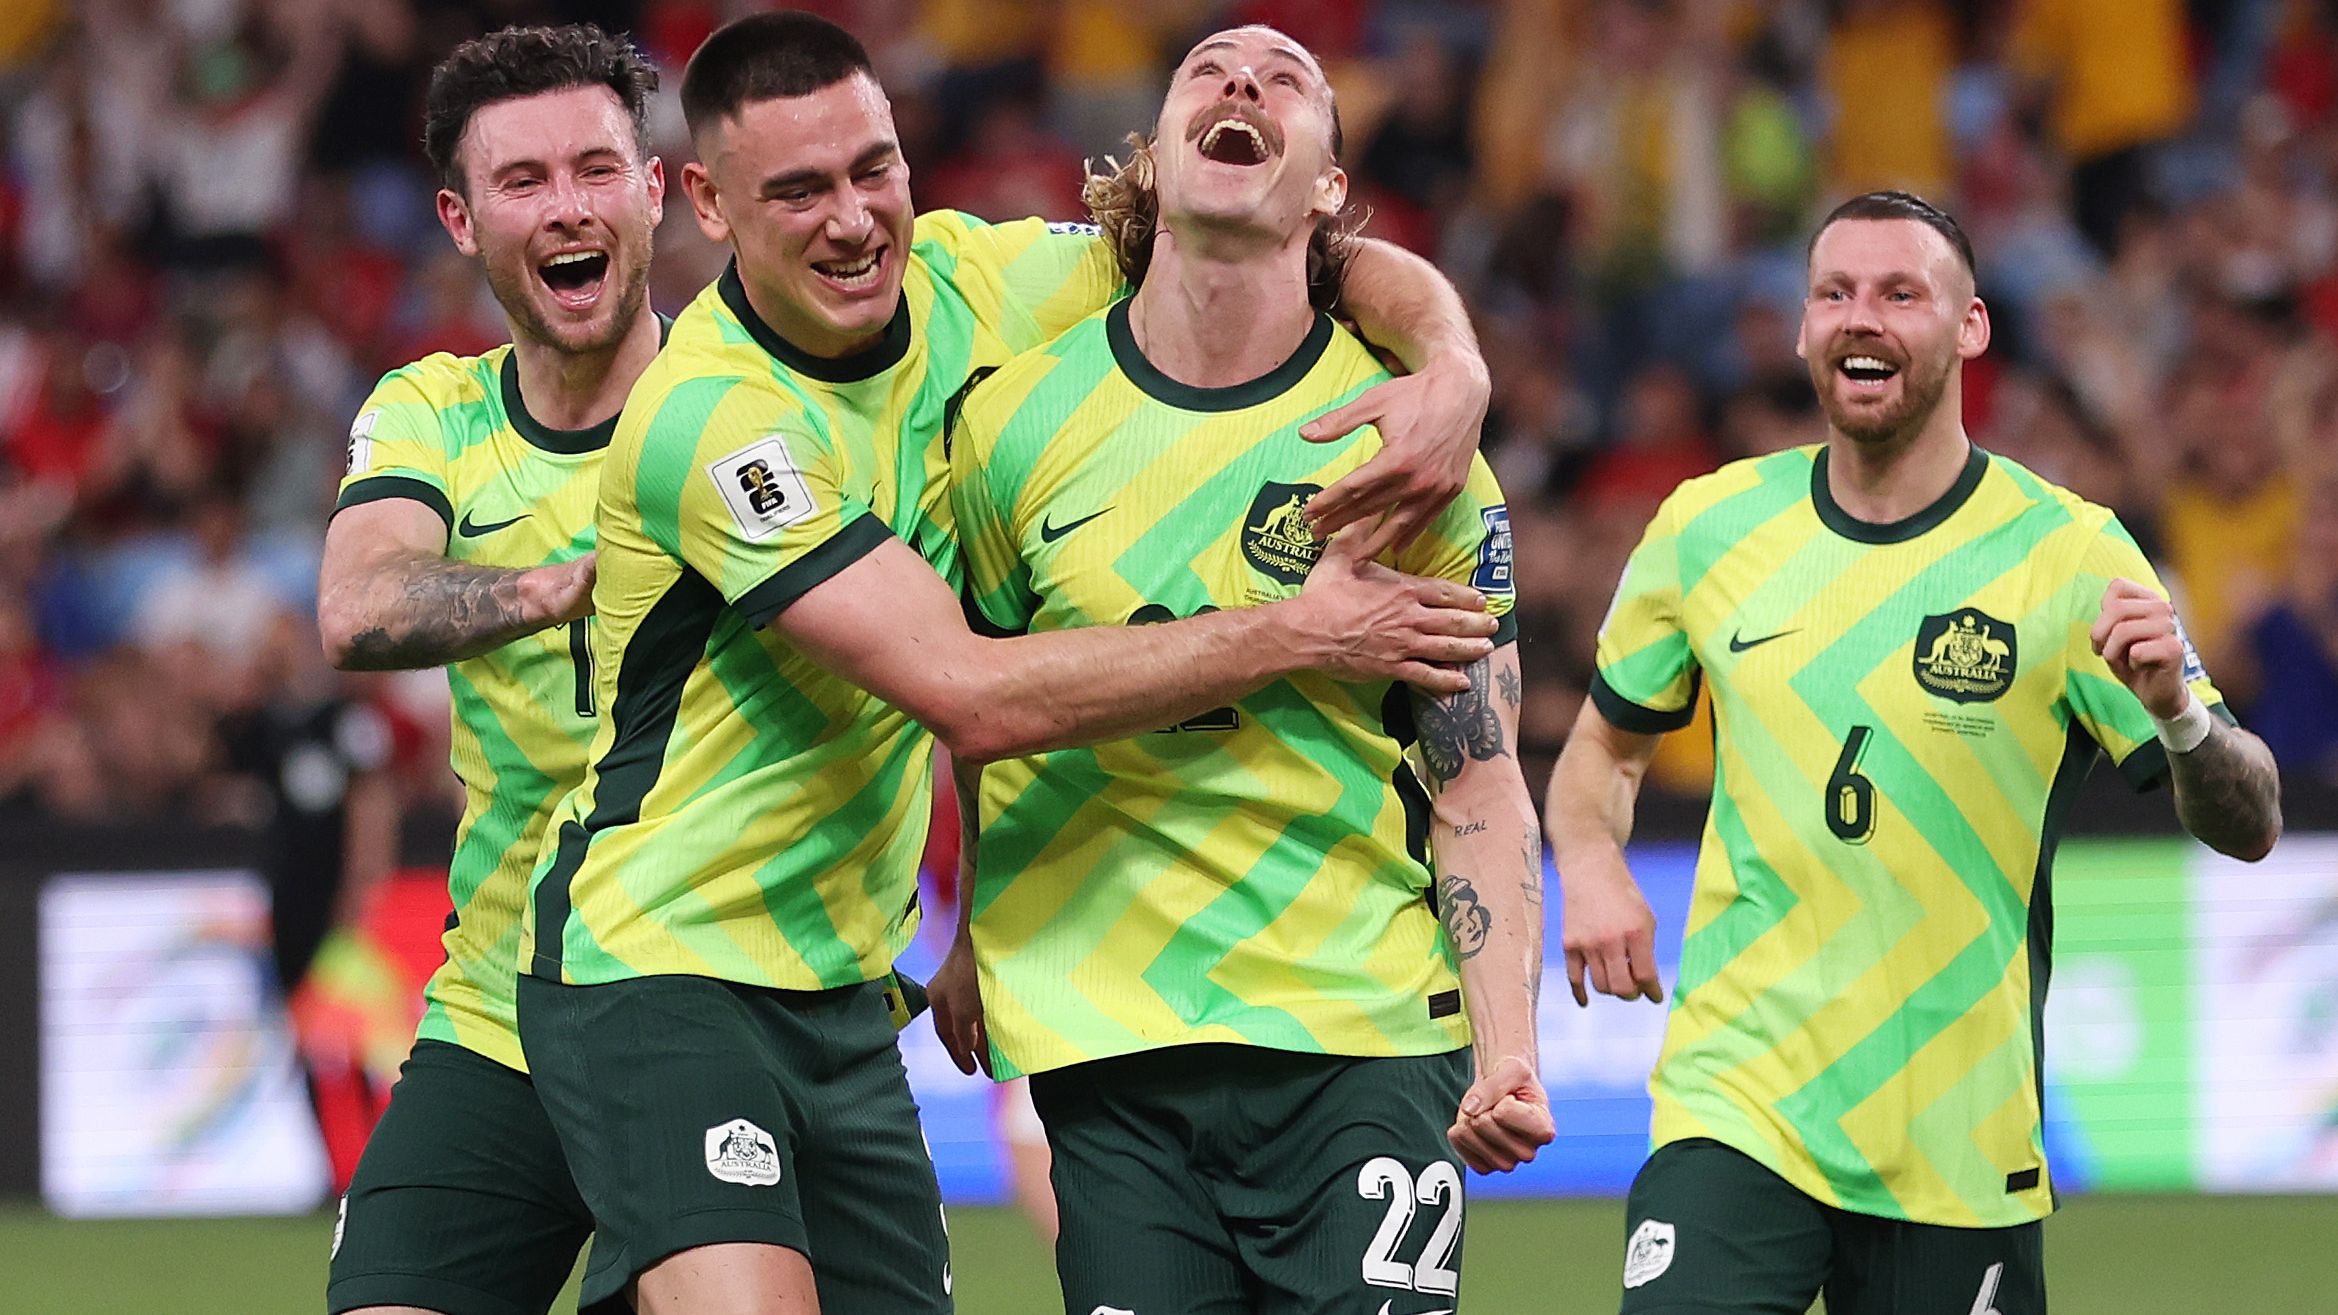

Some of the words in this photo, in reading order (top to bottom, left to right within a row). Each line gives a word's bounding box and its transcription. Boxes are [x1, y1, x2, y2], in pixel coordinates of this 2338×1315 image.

[1930, 664, 1997, 680] AUSTRALIA
[1824, 724, 1878, 846] 6
[1454, 819, 1487, 837] REAL
[721, 1160, 771, 1171] AUSTRALIA
[1357, 1156, 1464, 1299] 22
